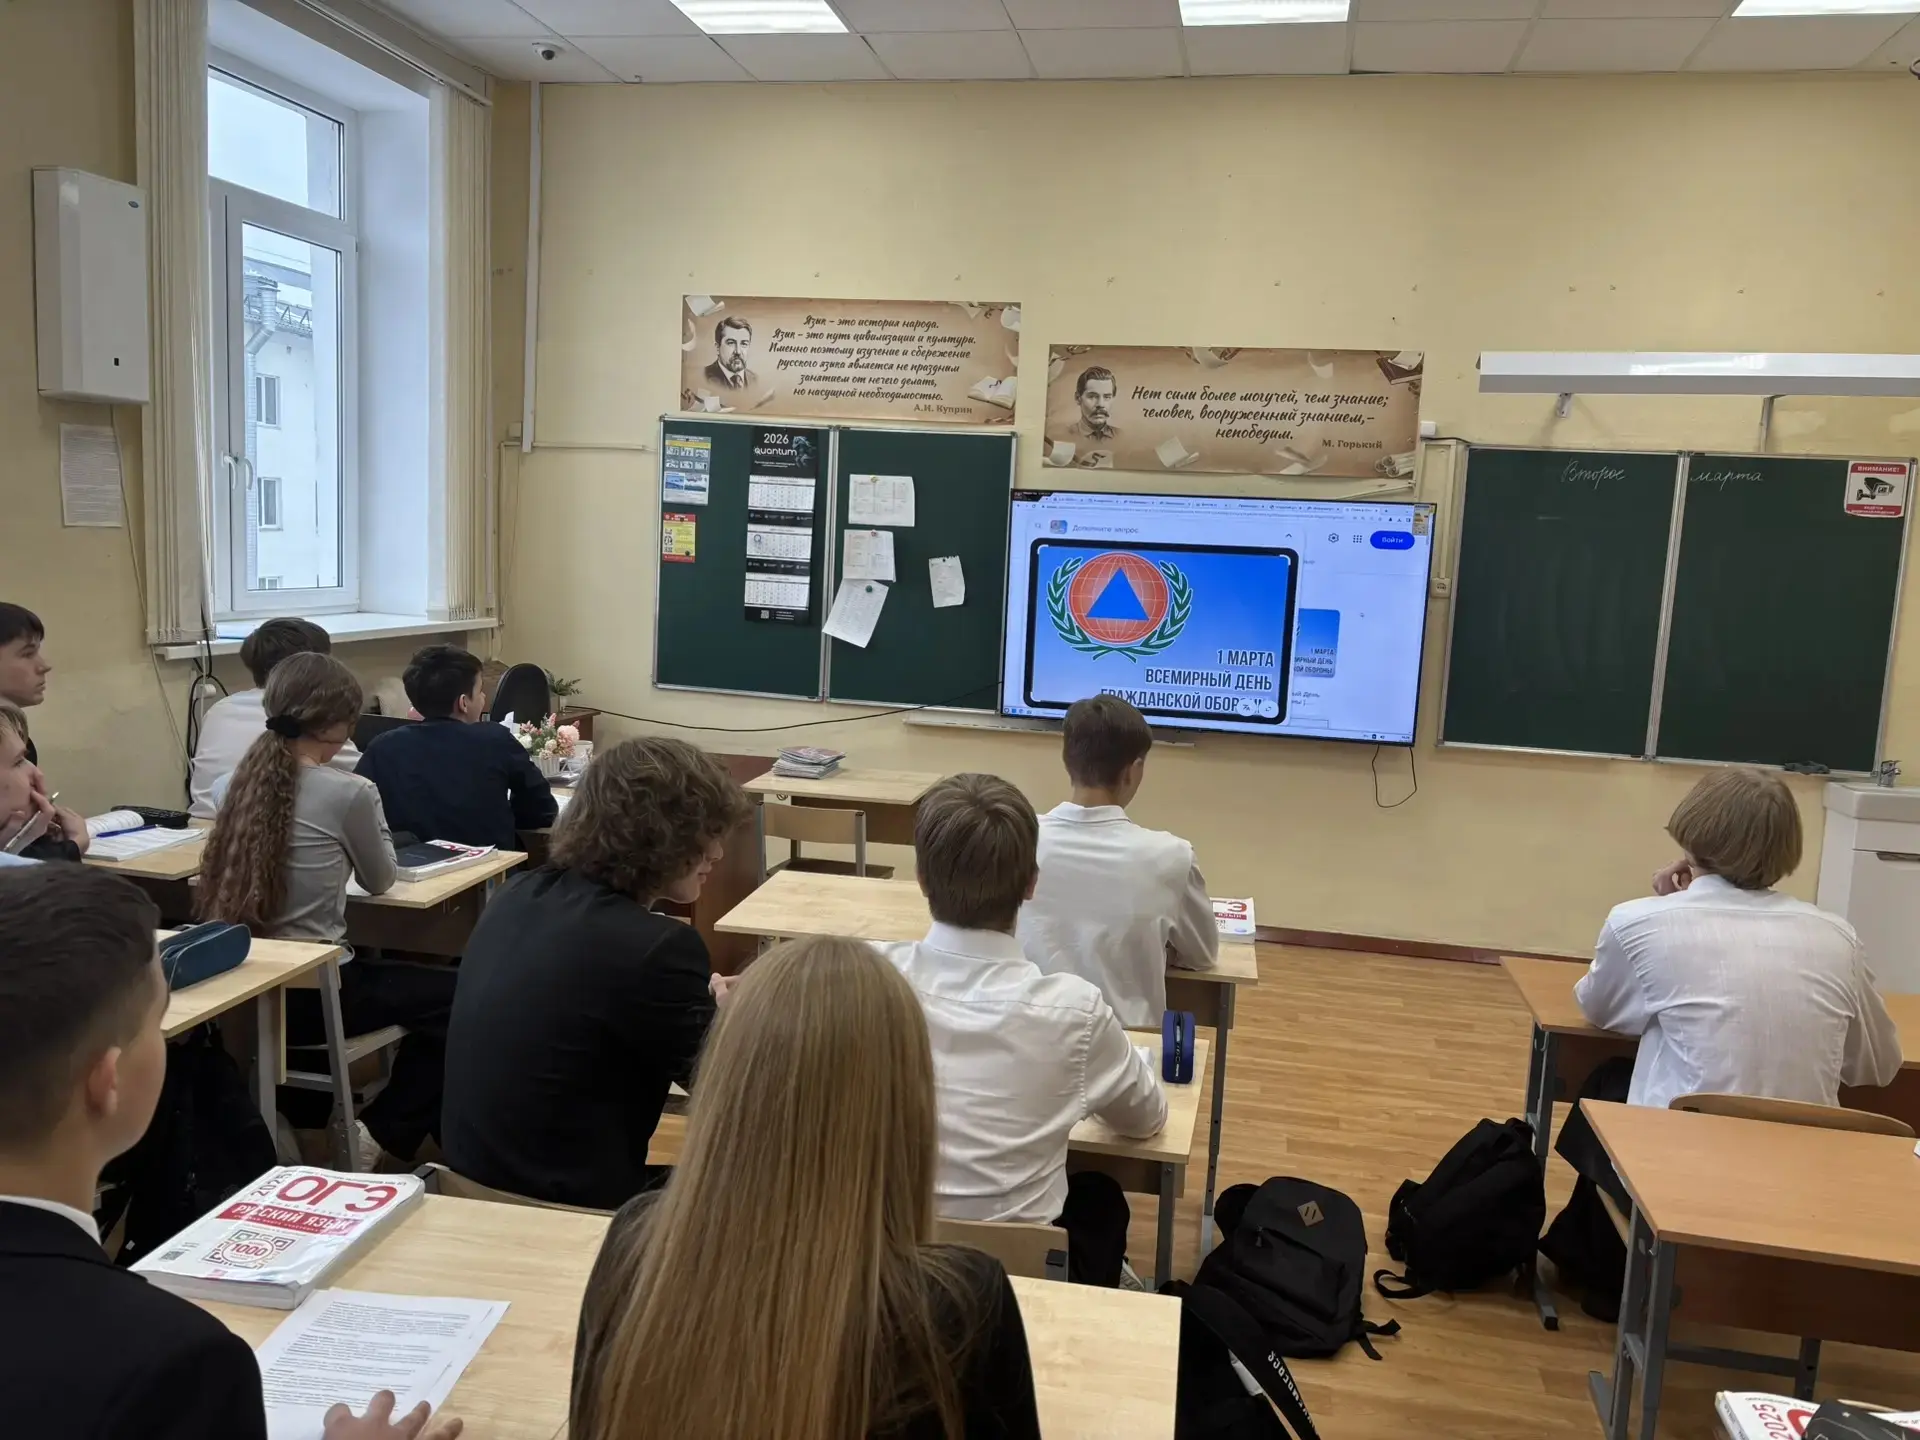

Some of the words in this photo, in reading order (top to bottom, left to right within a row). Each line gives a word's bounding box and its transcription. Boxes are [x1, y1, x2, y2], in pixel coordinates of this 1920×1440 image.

[803, 314, 827, 329] Язык
[837, 318, 856, 327] это
[858, 318, 900, 331] история
[902, 319, 939, 332] народа.
[772, 328, 796, 342] Язык
[805, 331, 824, 339] это
[826, 332, 851, 344] путь
[853, 329, 916, 345] цивилизации
[926, 335, 976, 347] культуры.
[769, 342, 808, 354] Именно
[810, 345, 854, 358] поэтому
[856, 347, 900, 359] изучение
[911, 346, 971, 360] сбережение
[776, 358, 818, 370] русского
[819, 360, 845, 372] языка
[847, 358, 894, 371] является
[910, 364, 960, 375] праздным
[798, 374, 850, 385] занятием
[852, 376, 866, 384] от
[900, 377, 937, 389] делать,
[793, 388, 806, 396] но
[807, 388, 857, 400] насущной
[858, 387, 943, 403] необходимостью.
[1131, 385, 1162, 400] Нет
[1165, 389, 1197, 400] силы
[1200, 385, 1236, 401] более
[1240, 389, 1298, 407] могучей,
[1304, 393, 1330, 403] чем
[1330, 394, 1389, 409] знание;
[936, 405, 973, 415] Куприн
[1142, 403, 1194, 420] человек,
[1200, 404, 1299, 425] вооруженный
[763, 433, 789, 444] 2026
[1215, 423, 1293, 444] непобедим.
[1321, 439, 1334, 448] М.
[1337, 440, 1382, 449] Горький
[1562, 458, 1625, 489] Второе
[1690, 471, 1764, 491] марта
[1217, 650, 1223, 665] 1
[1227, 651, 1274, 667] МАРТА
[1145, 668, 1232, 689] ВСЕМИРНЫЙ
[1234, 674, 1272, 691] ДЕНЬ
[276, 1175, 398, 1212] ОГЭ
[232, 1203, 303, 1224] РУССКИЙ
[305, 1215, 353, 1231] ЯЗЫК
[231, 1243, 268, 1256] 1000
